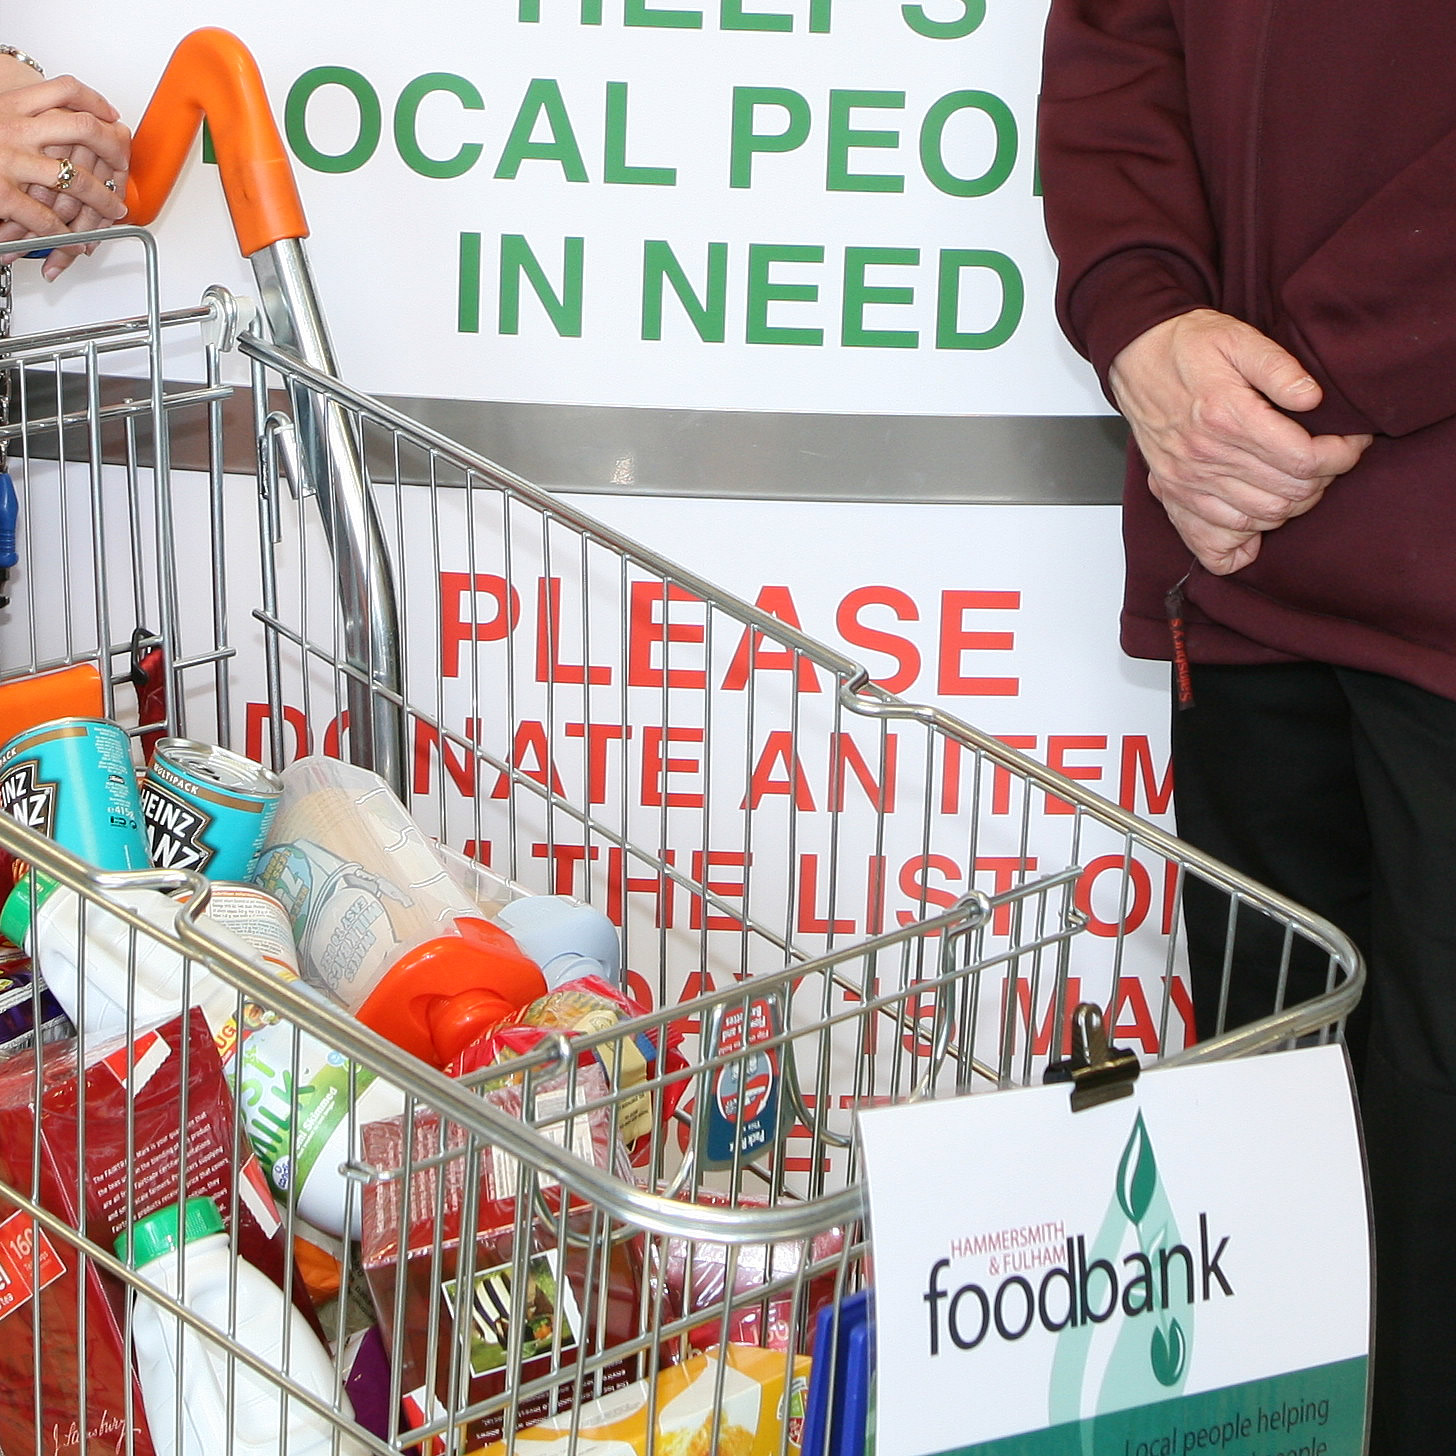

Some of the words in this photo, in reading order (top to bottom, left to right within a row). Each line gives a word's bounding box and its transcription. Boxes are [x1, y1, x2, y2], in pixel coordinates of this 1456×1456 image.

[202, 65, 678, 187] OCAL
[729, 85, 1044, 199] PEO
[456, 231, 585, 339] IN
[641, 240, 1026, 351] NEED
[439, 571, 1021, 696] PLEASE
[153, 763, 200, 795] MULTIPACK
[739, 730, 897, 813] AN
[796, 853, 1038, 938] LIST
[303, 1087, 338, 1131] Skimmed
[748, 1129, 765, 1150] Pack
[950, 1220, 1066, 1260] HAMMERSMITH
[988, 1258, 1001, 1276] &
[1002, 1247, 1066, 1274] FULHAM
[923, 1211, 1235, 1356] foodbank
[1125, 1427, 1177, 1456] Local
[1183, 1413, 1252, 1456] people
[1257, 1399, 1330, 1433] helping
